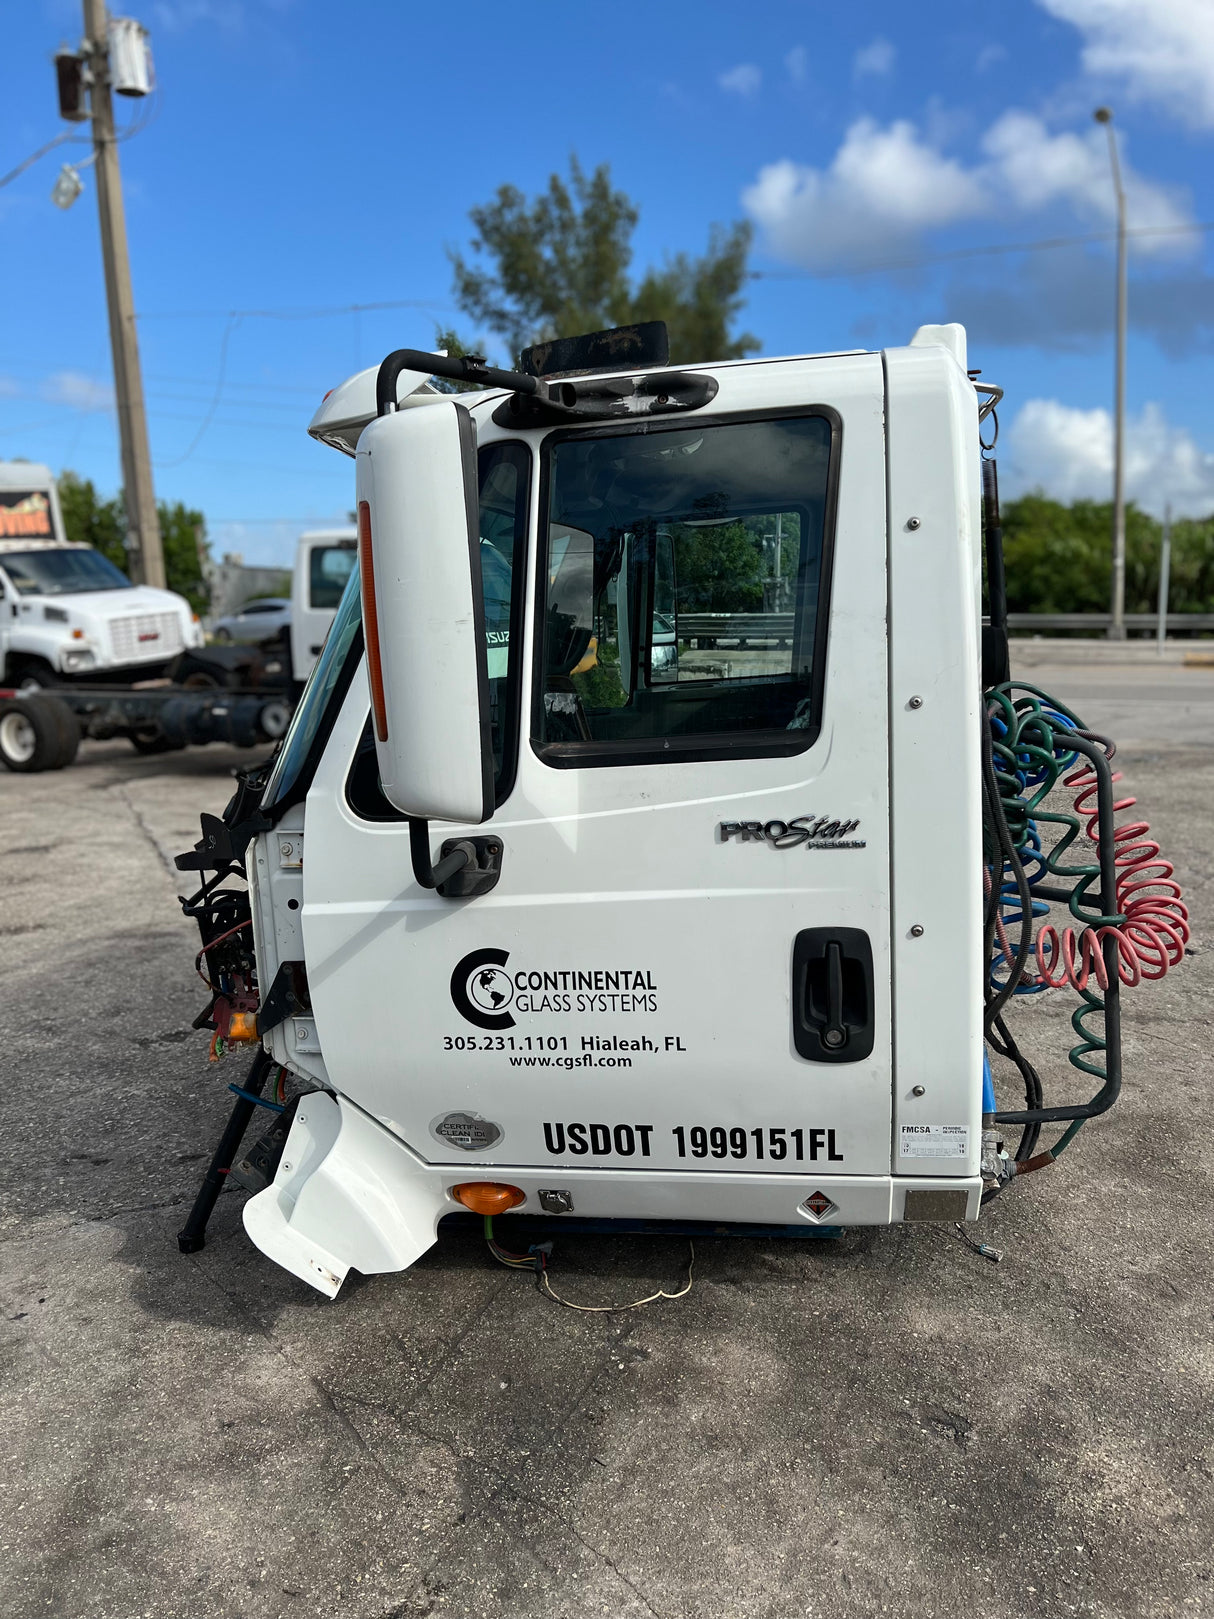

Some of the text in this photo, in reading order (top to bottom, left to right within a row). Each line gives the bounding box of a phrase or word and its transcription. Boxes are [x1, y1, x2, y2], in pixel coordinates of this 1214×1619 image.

[514, 970, 658, 991] CONTINENTAL
[515, 993, 658, 1013] GLASS SYSTEMS
[443, 1035, 687, 1054] 305.231.1101 Hialeah, FL
[509, 1053, 633, 1070] www.cgsfl.com
[440, 1129, 471, 1137] CLEAN
[901, 1126, 931, 1134] FMCSA
[543, 1122, 844, 1162] USDOT 1999151FL
